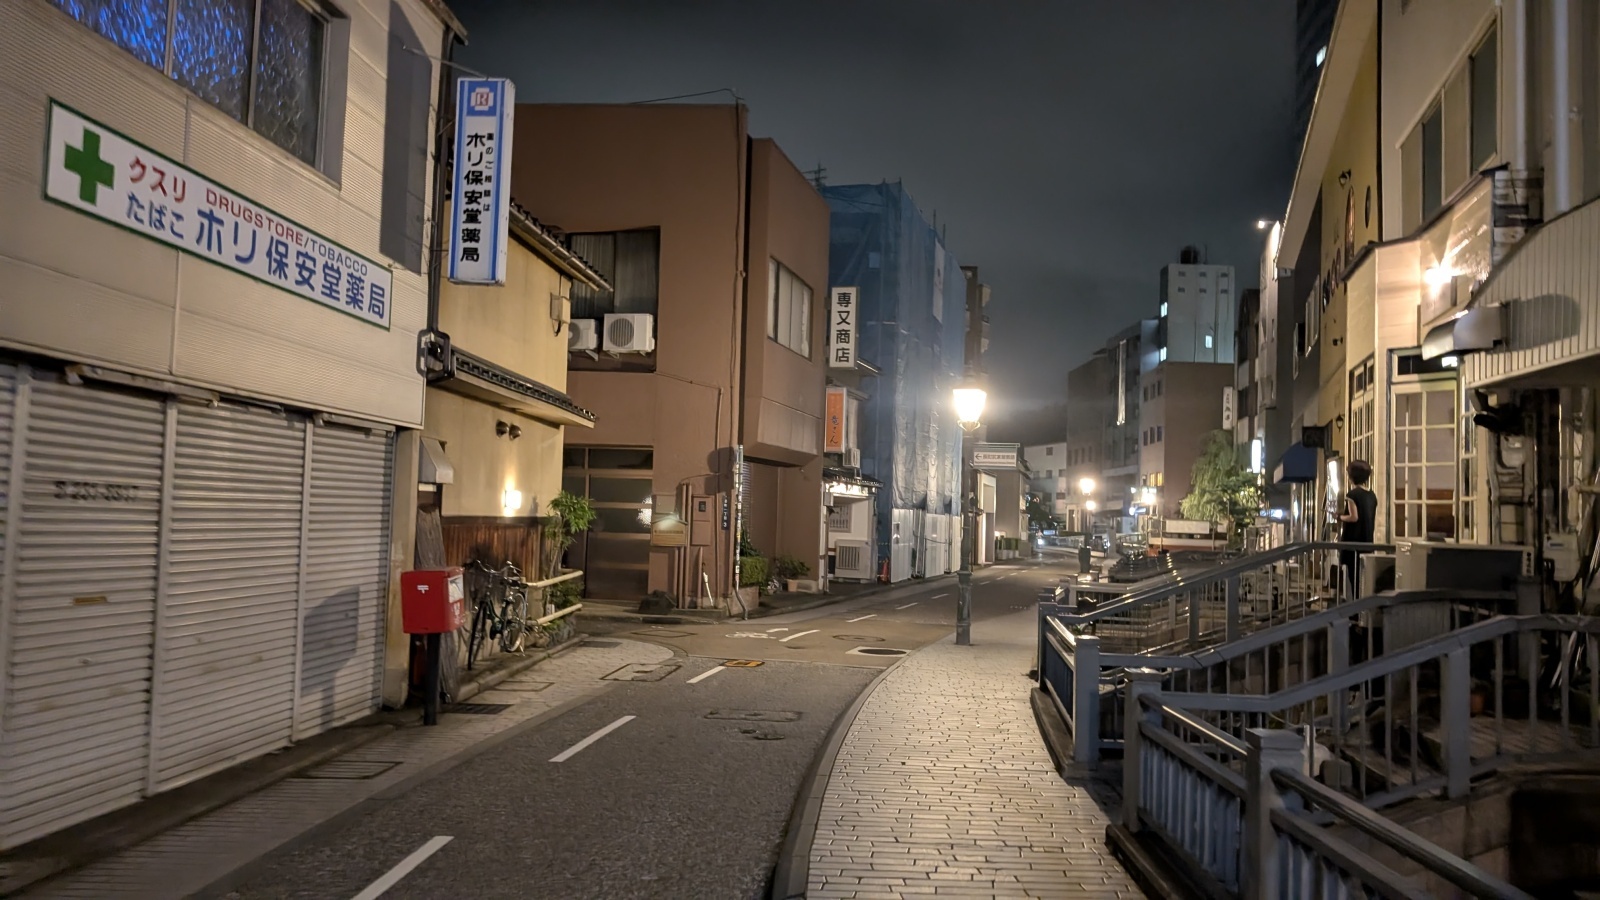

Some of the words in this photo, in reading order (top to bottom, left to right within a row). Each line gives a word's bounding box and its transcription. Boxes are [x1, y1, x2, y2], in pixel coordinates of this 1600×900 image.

[127, 191, 185, 240] たばこ
[129, 156, 186, 203] クスリ
[460, 132, 486, 262] ホリ保安堂薬局
[196, 207, 385, 319] ホリ保安堂薬局
[206, 189, 368, 277] DRUGSTORE/TOBACCO
[835, 292, 852, 363] 専又商店
